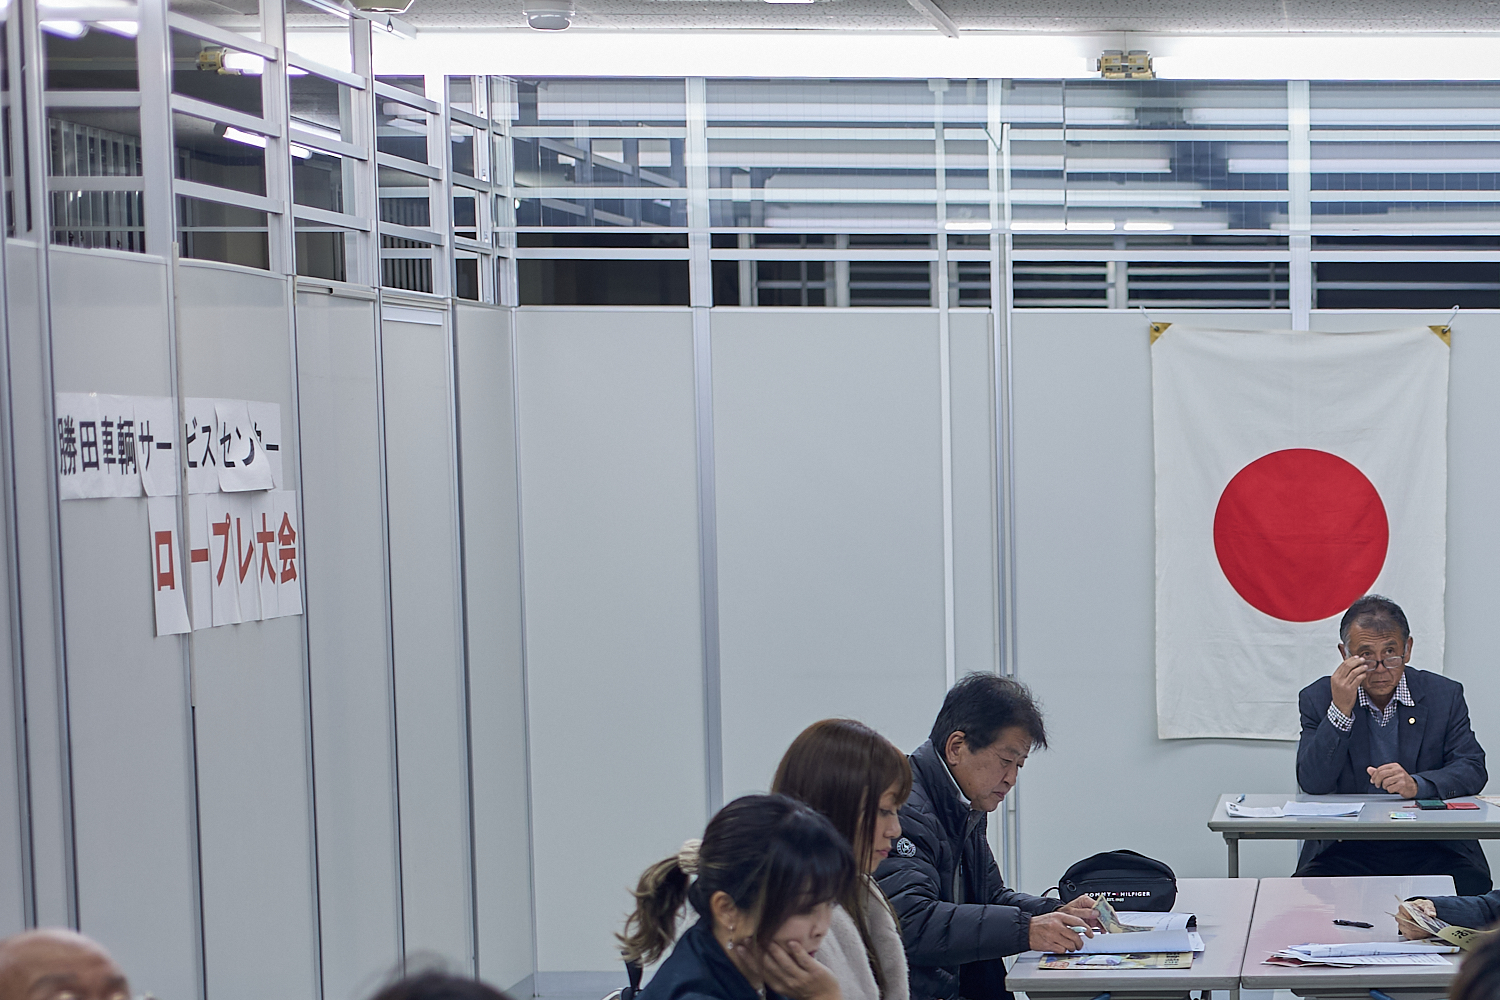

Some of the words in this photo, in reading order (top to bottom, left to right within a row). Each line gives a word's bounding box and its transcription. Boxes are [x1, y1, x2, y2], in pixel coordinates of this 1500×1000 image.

[155, 512, 297, 591] ロープレ大会
